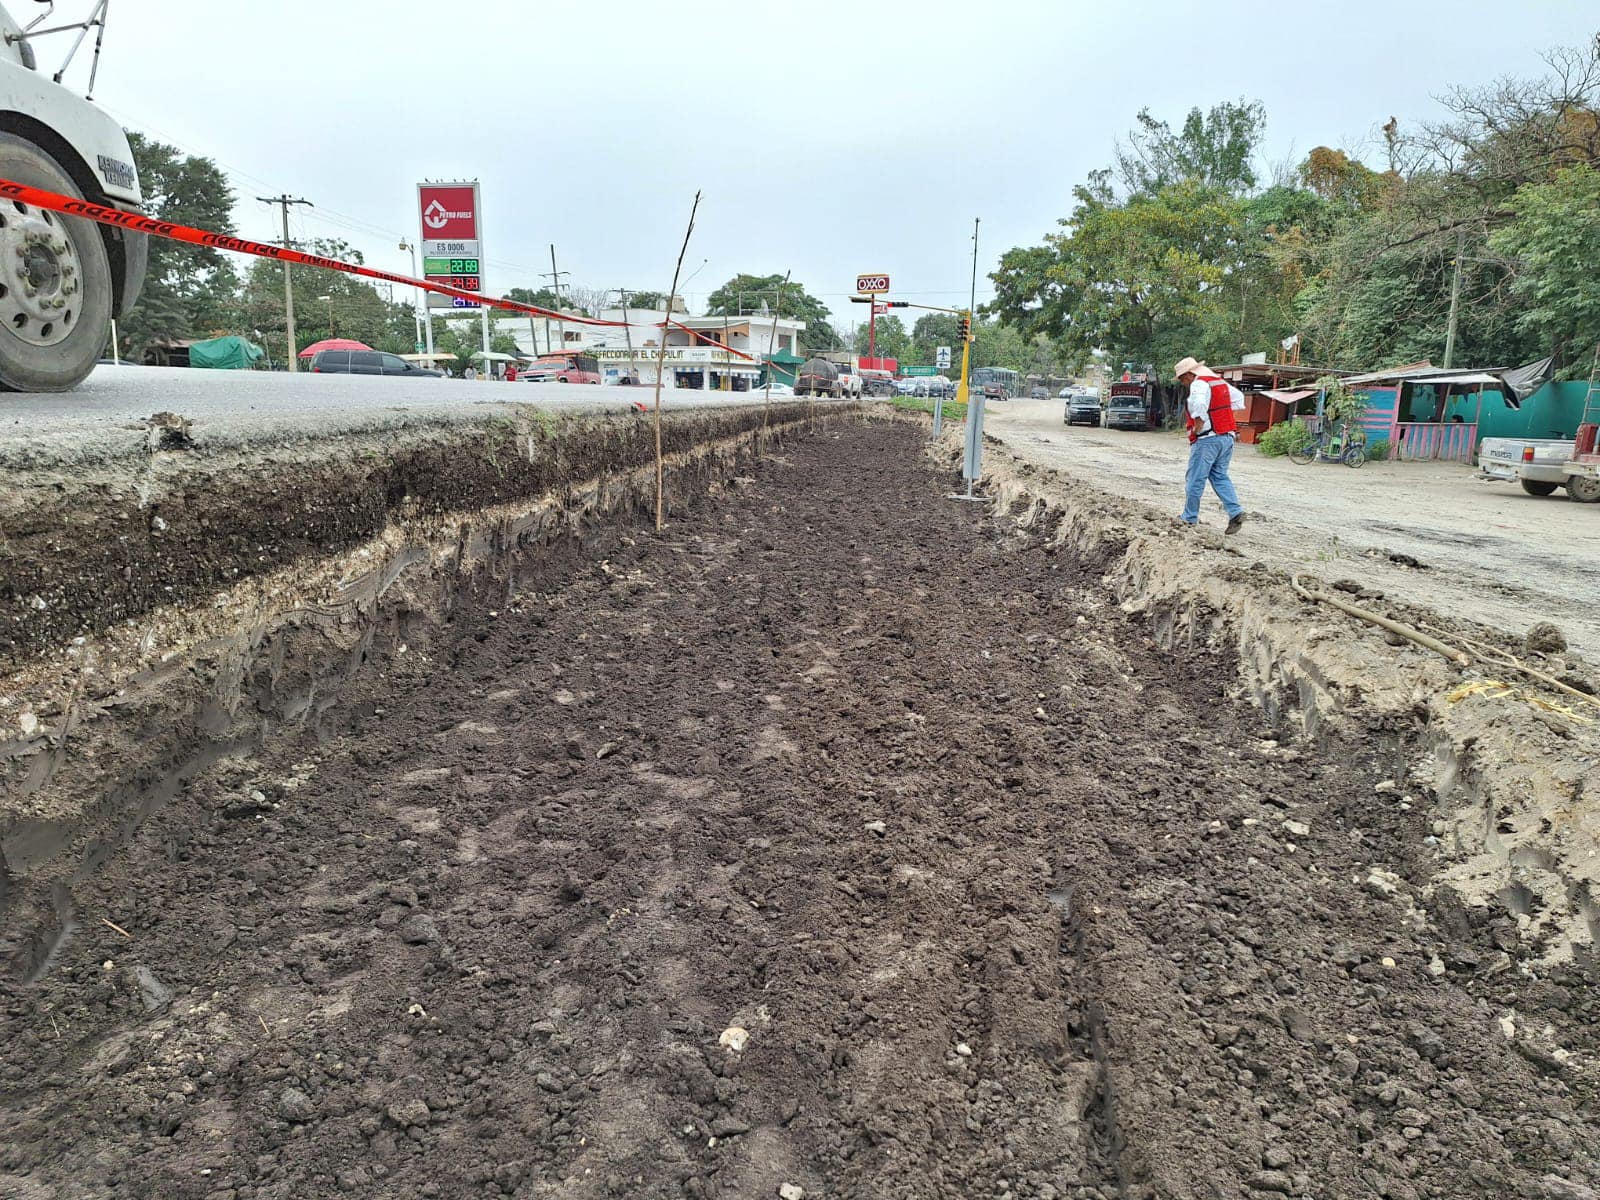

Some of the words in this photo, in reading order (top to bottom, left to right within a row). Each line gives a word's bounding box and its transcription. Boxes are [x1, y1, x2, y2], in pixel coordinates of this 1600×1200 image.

[437, 243, 446, 251] ES
[451, 260, 477, 272] 22.69
[858, 278, 886, 290] OXXO
